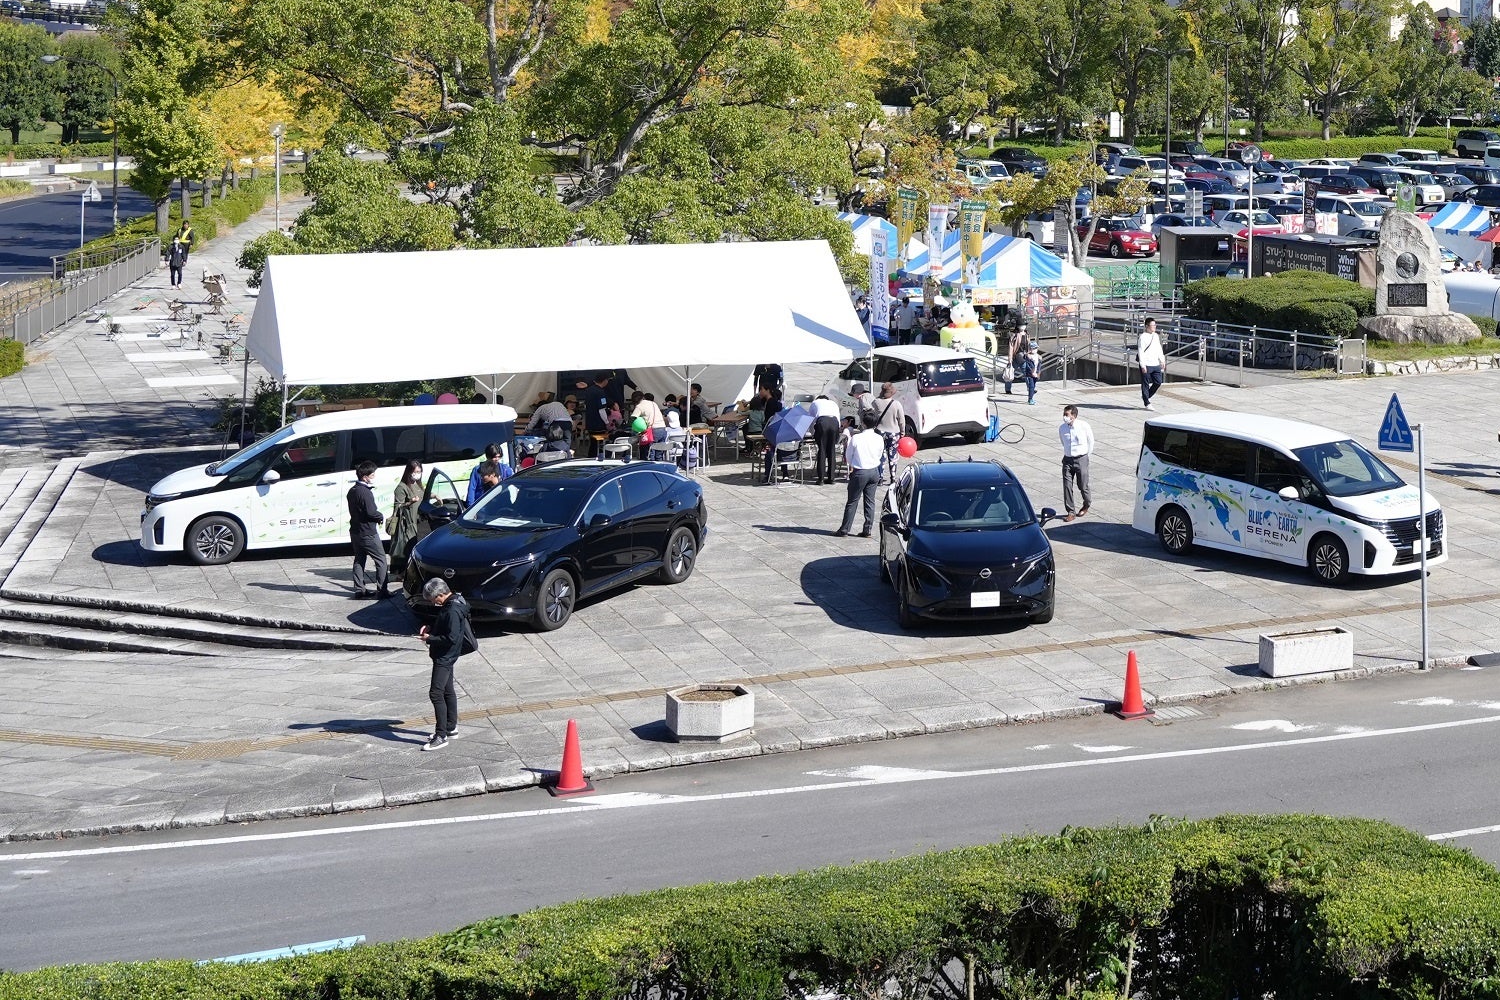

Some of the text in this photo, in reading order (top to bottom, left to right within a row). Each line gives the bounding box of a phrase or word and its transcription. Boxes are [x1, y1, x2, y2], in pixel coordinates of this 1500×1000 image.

[973, 213, 983, 233] 試食
[1299, 252, 1327, 266] coming
[1338, 264, 1351, 275] you
[280, 516, 336, 526] SERENA
[1248, 508, 1298, 533] BLUE EARTH
[1278, 511, 1299, 519] NISSAN
[1246, 525, 1297, 544] SERENA
